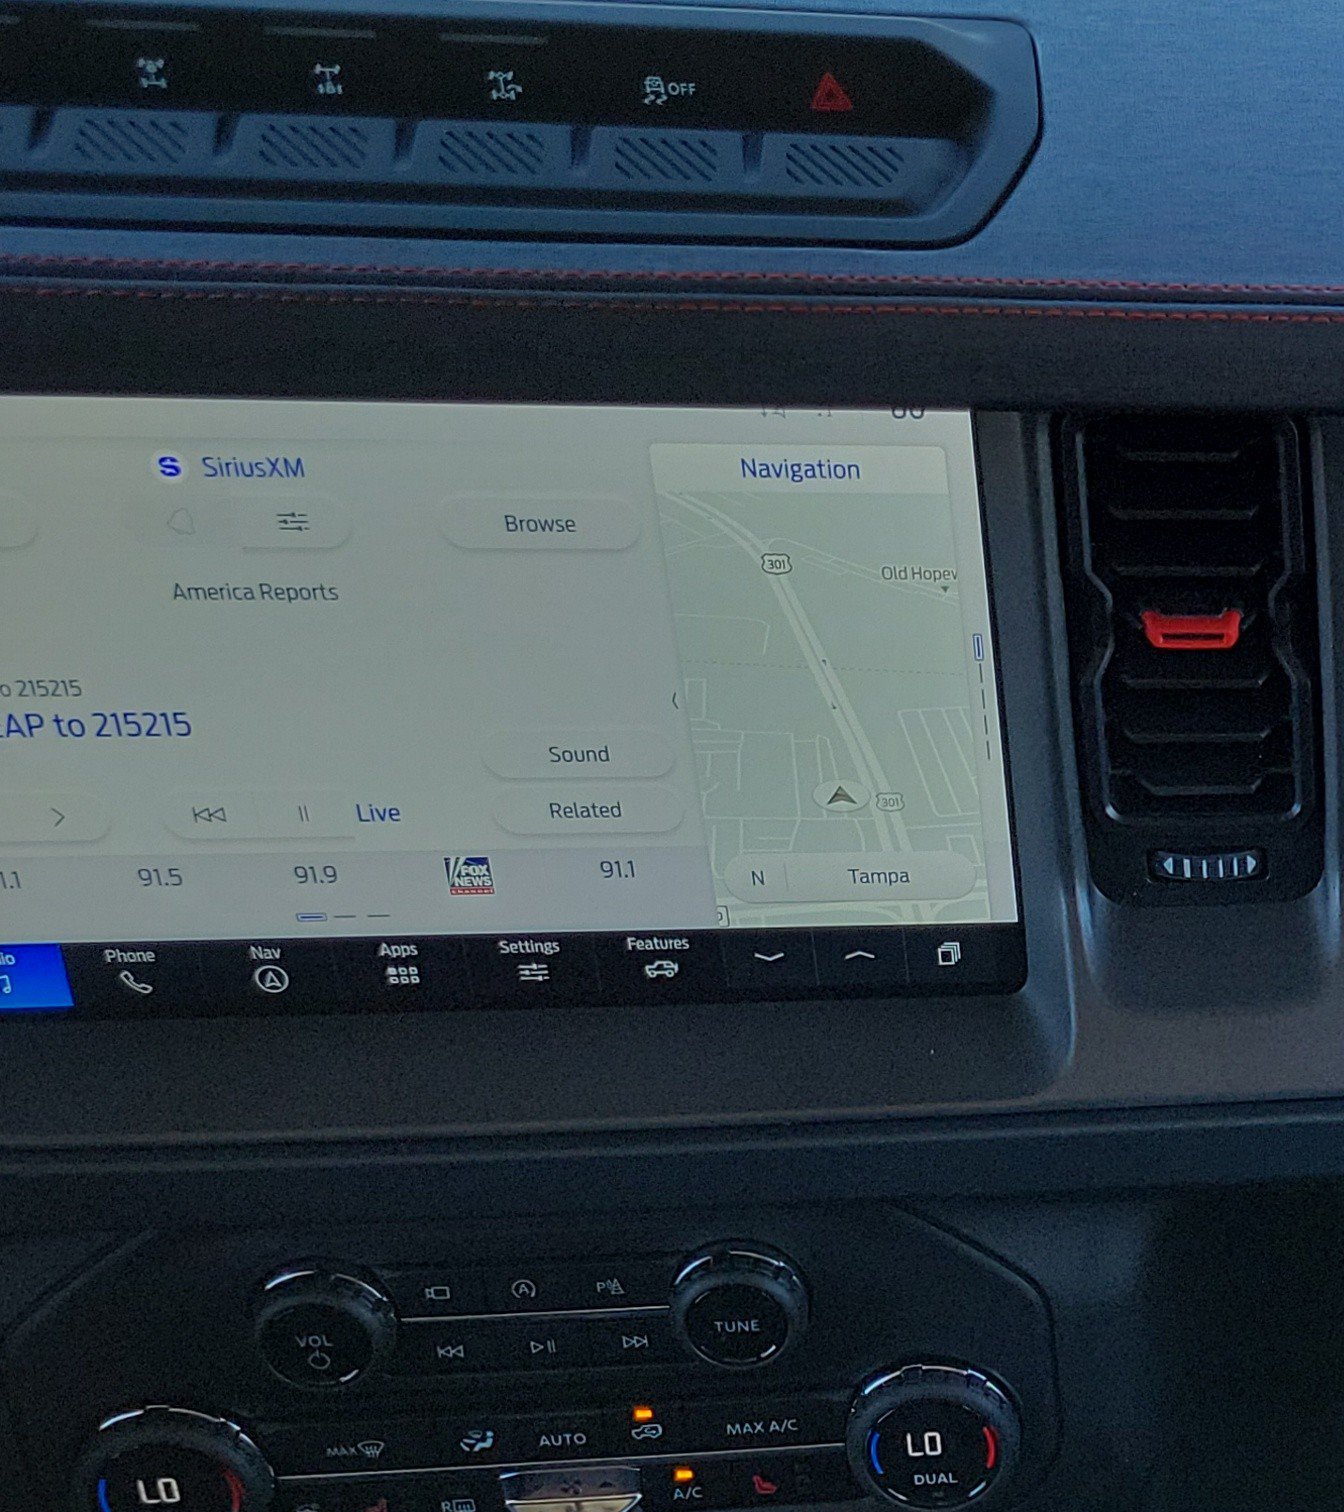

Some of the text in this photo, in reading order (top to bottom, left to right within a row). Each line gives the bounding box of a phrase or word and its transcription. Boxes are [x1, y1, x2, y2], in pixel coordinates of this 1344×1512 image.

[668, 82, 695, 96] OFF
[202, 457, 305, 478] SiriusXM
[741, 458, 861, 483] Navigation
[505, 515, 577, 533] Browse
[767, 558, 787, 571] 301
[881, 566, 908, 580] Old
[173, 583, 339, 603] America Reports
[15, 679, 82, 697] 215215
[0, 712, 192, 738] AP to 215215
[549, 745, 610, 763] Sound
[356, 804, 400, 823] Live
[549, 802, 622, 820] Related
[138, 868, 183, 887] 91.5
[293, 865, 338, 885] 91.9
[461, 865, 490, 876] FOX
[599, 860, 637, 879] 91.1
[848, 869, 910, 886] Tampa
[454, 876, 493, 887] NEWS
[751, 871, 765, 886] N
[379, 942, 418, 959] Apps
[500, 938, 560, 956] Settings
[626, 936, 690, 951] Features
[105, 950, 156, 963] Phone
[250, 946, 281, 960] Nav
[714, 1320, 760, 1334] TUNE
[295, 1335, 334, 1348] VOL
[726, 1418, 799, 1436] MAX A/C
[539, 1432, 587, 1448] AUTO
[906, 1432, 943, 1458] LO
[327, 1446, 358, 1457] MAX
[913, 1472, 958, 1486] DUAL
[137, 1477, 181, 1504] LO
[673, 1486, 703, 1501] A/C
